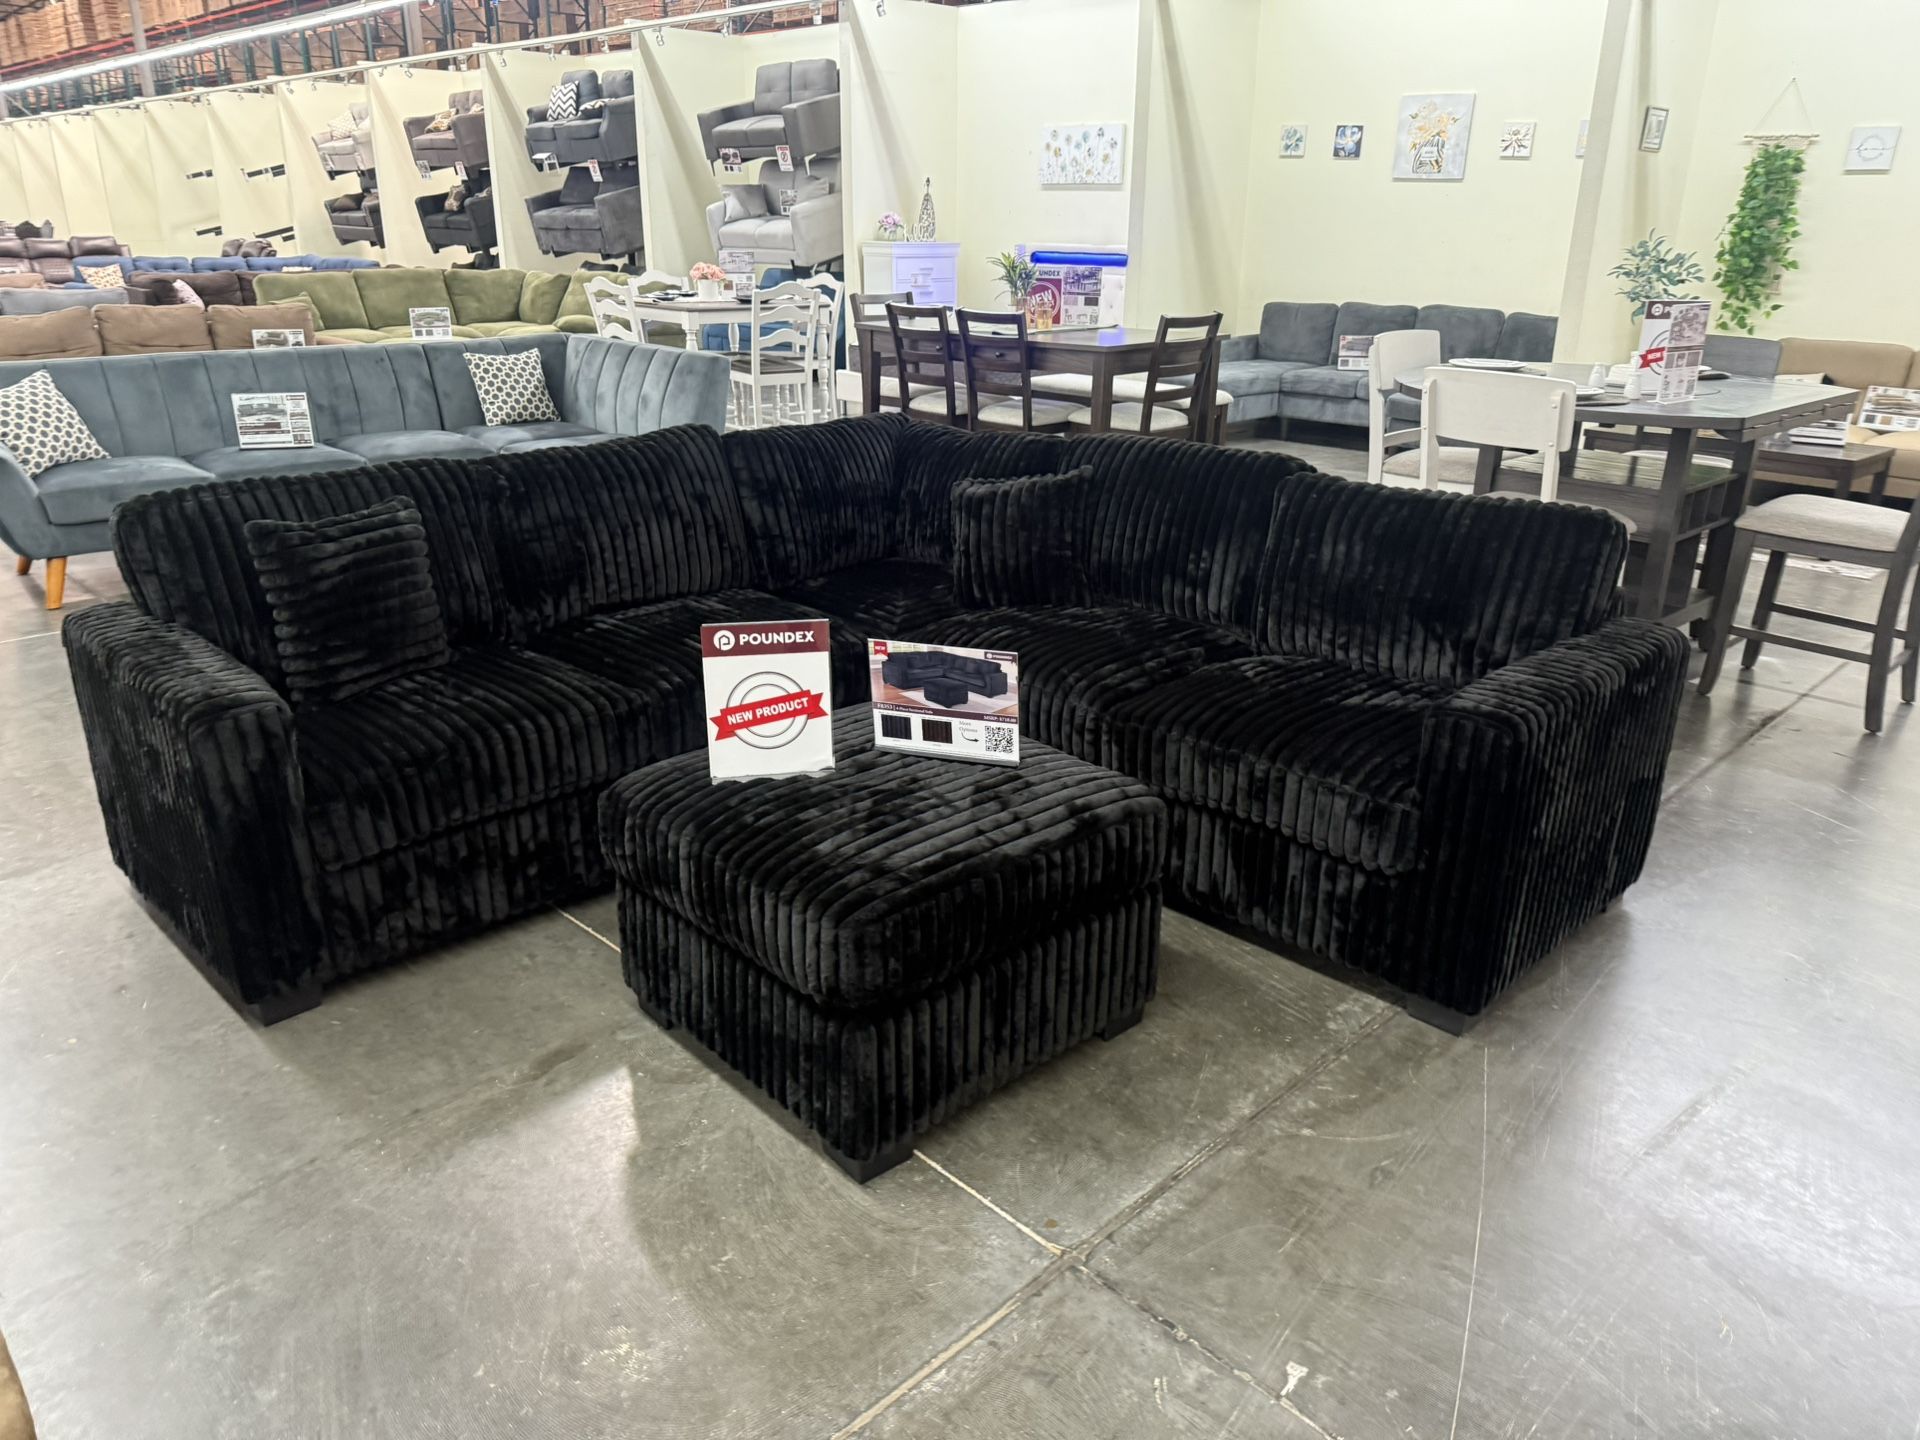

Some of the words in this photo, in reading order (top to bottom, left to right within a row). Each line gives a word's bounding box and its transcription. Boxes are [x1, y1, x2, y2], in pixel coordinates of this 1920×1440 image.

[1030, 289, 1053, 307] NEW
[739, 630, 815, 645] POUNDEX
[726, 709, 753, 725] NEW
[755, 697, 809, 718] PRODUCT
